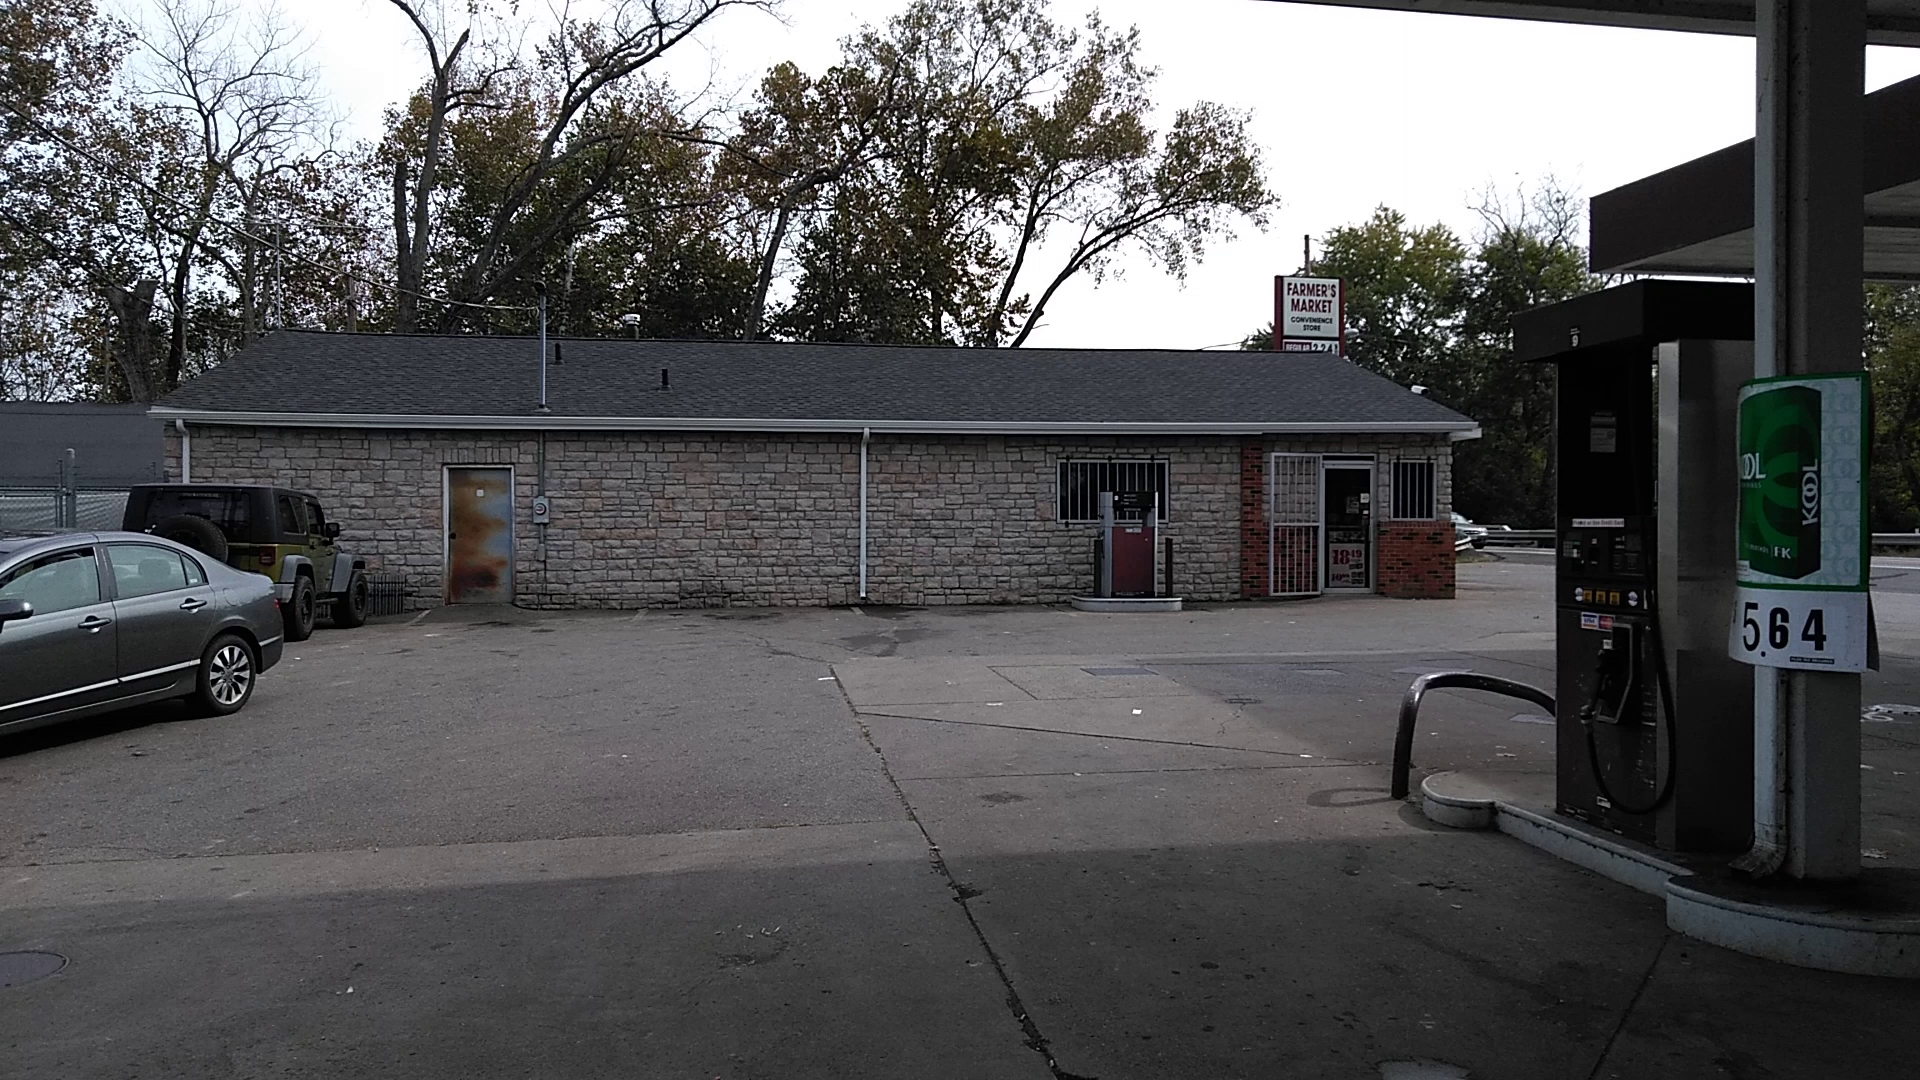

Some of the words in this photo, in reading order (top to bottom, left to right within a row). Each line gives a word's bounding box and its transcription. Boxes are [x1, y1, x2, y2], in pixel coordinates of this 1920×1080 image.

[1287, 283, 1336, 298] FARMER'S
[1291, 298, 1333, 313] MARKET
[1291, 316, 1333, 324] CONVENIENCE
[1572, 334, 1579, 347] 9
[1742, 452, 1767, 480] OOL
[1801, 458, 1819, 526] KOOL
[1774, 546, 1791, 559] FK
